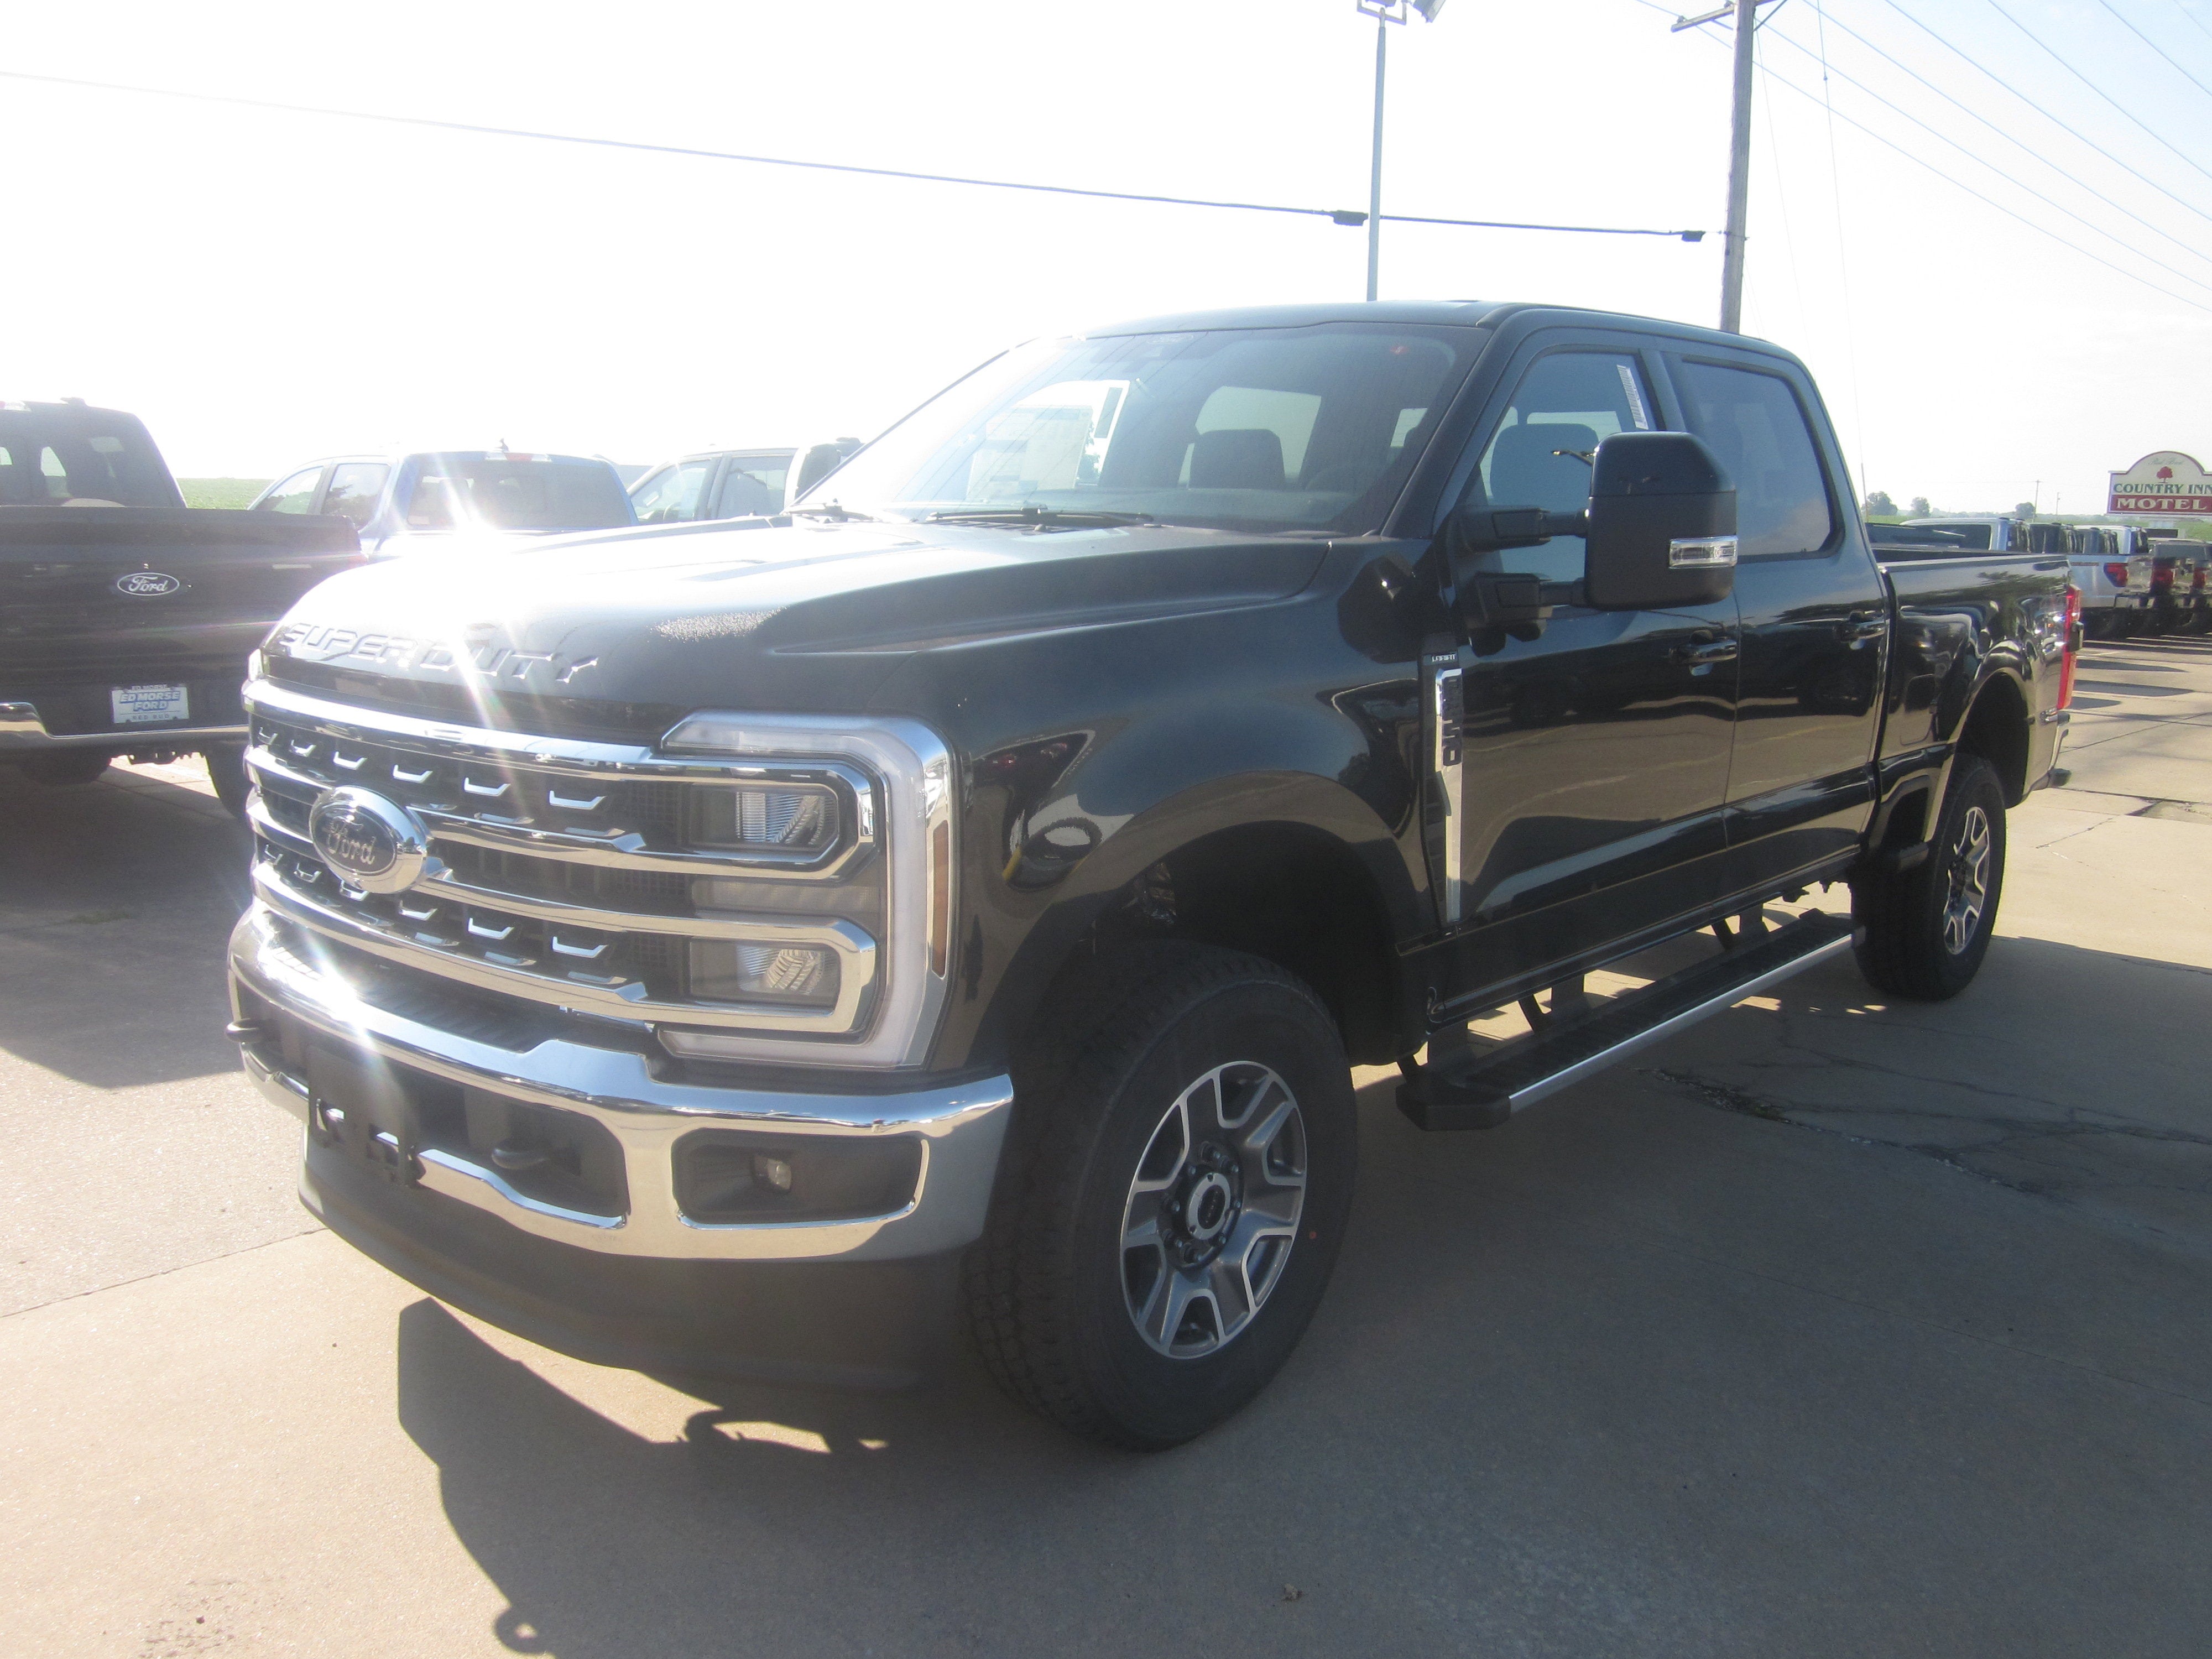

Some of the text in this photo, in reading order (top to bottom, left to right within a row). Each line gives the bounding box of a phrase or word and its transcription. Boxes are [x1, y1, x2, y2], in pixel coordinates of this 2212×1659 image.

[2114, 483, 2212, 495] COUNTRY INN
[2116, 498, 2207, 510] MOTEL
[128, 575, 168, 592] Ford
[279, 623, 418, 669] SUPER
[119, 691, 180, 703] ED MORSE
[133, 701, 168, 712] FORD
[327, 815, 377, 865] Ford
